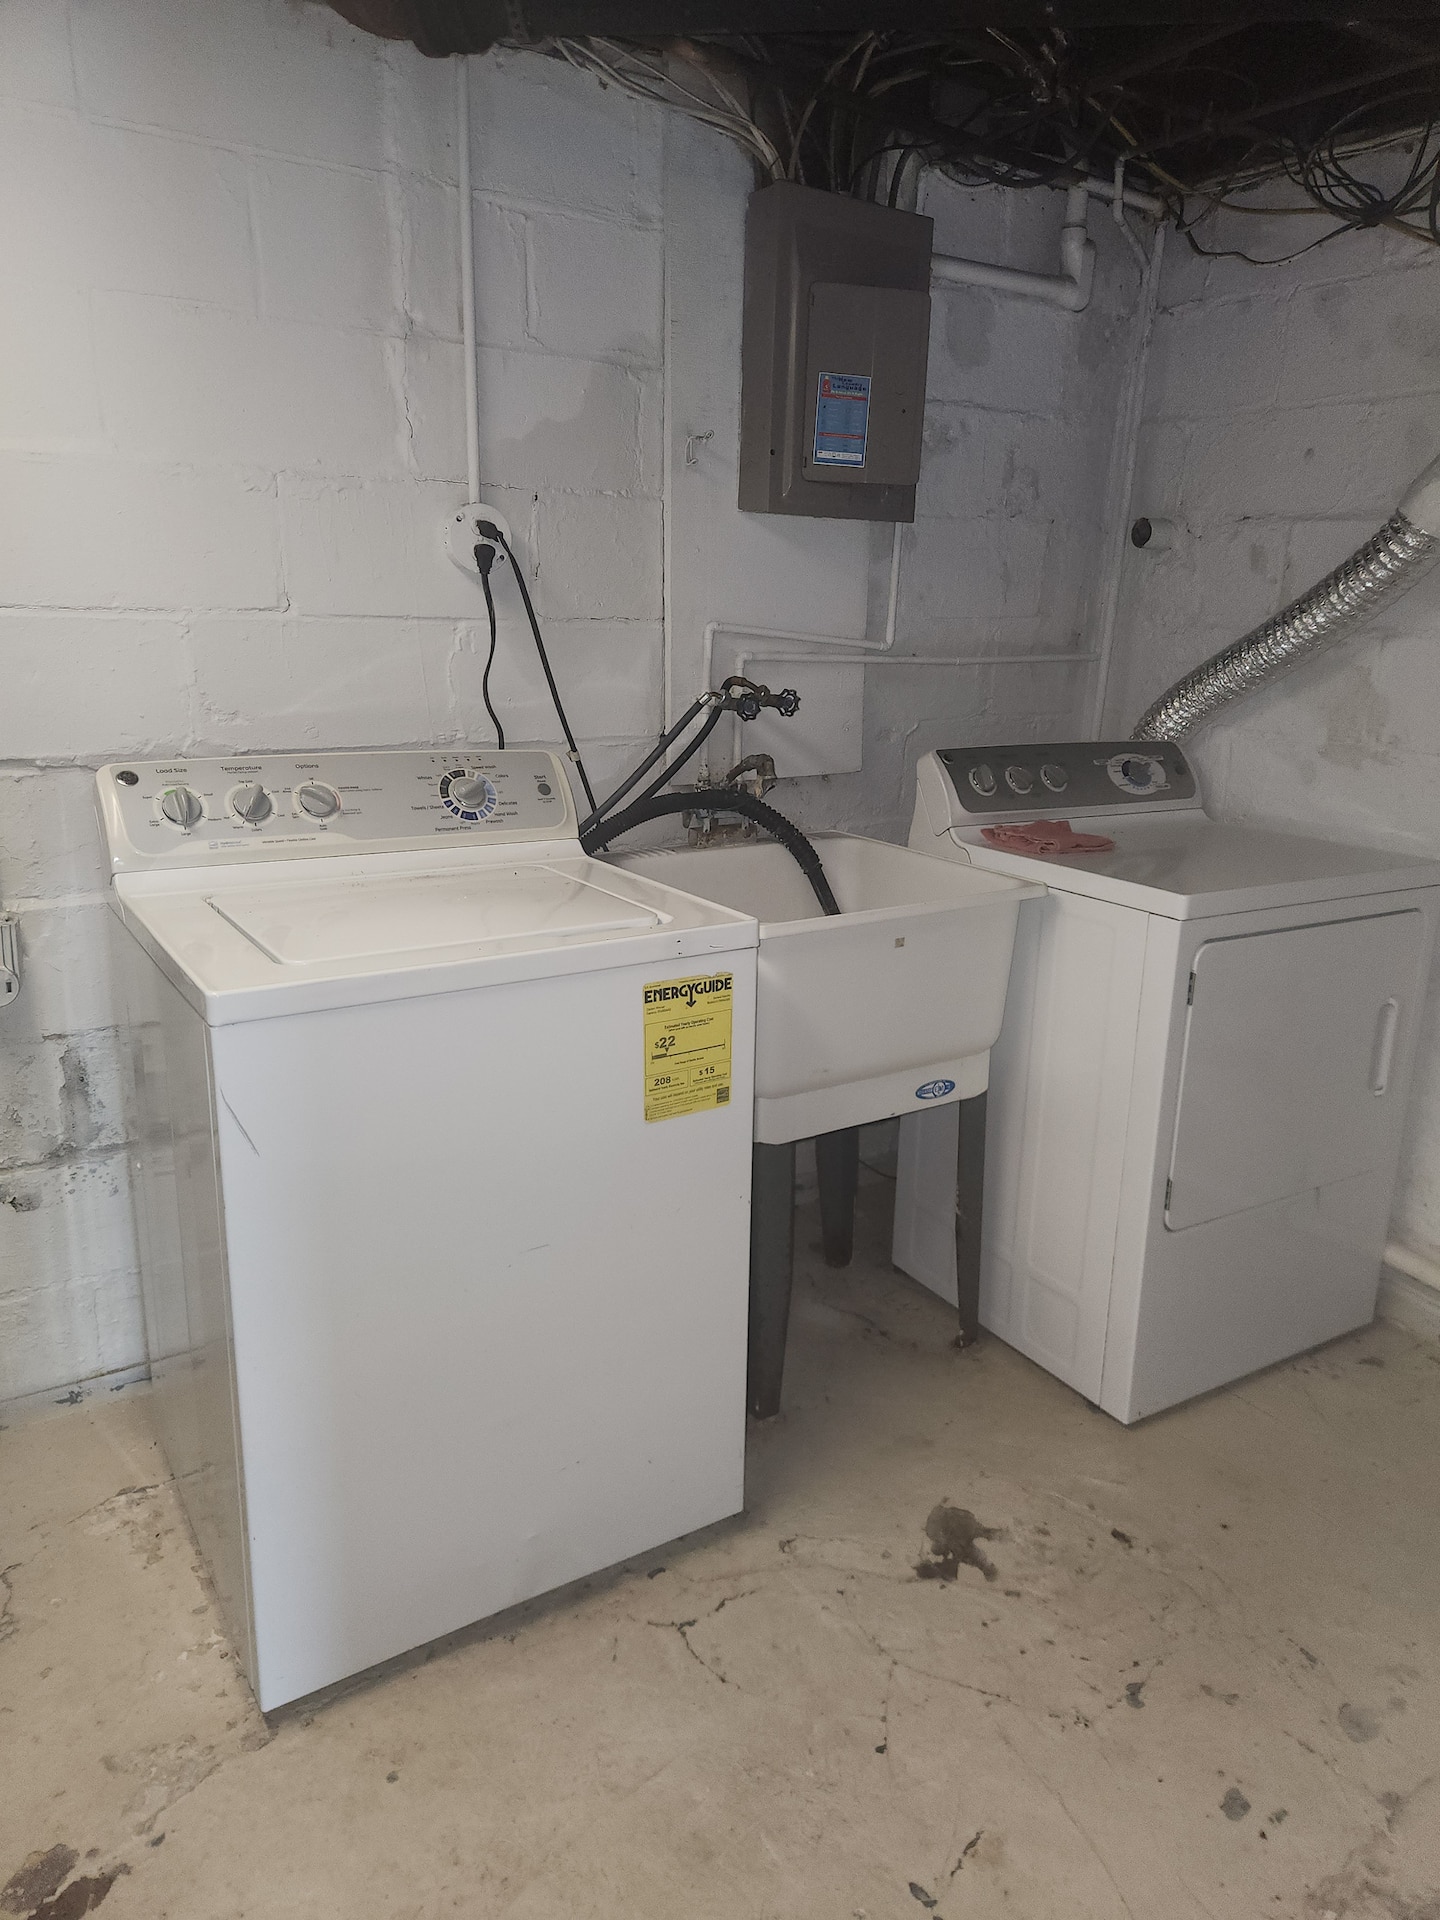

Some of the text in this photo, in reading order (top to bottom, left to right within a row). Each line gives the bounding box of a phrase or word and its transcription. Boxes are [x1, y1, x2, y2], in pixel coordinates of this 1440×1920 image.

[644, 977, 732, 1006] ENERGYGUIDE
[655, 1035, 676, 1049] $22
[699, 1066, 715, 1076] $15
[654, 1076, 671, 1086] 208
